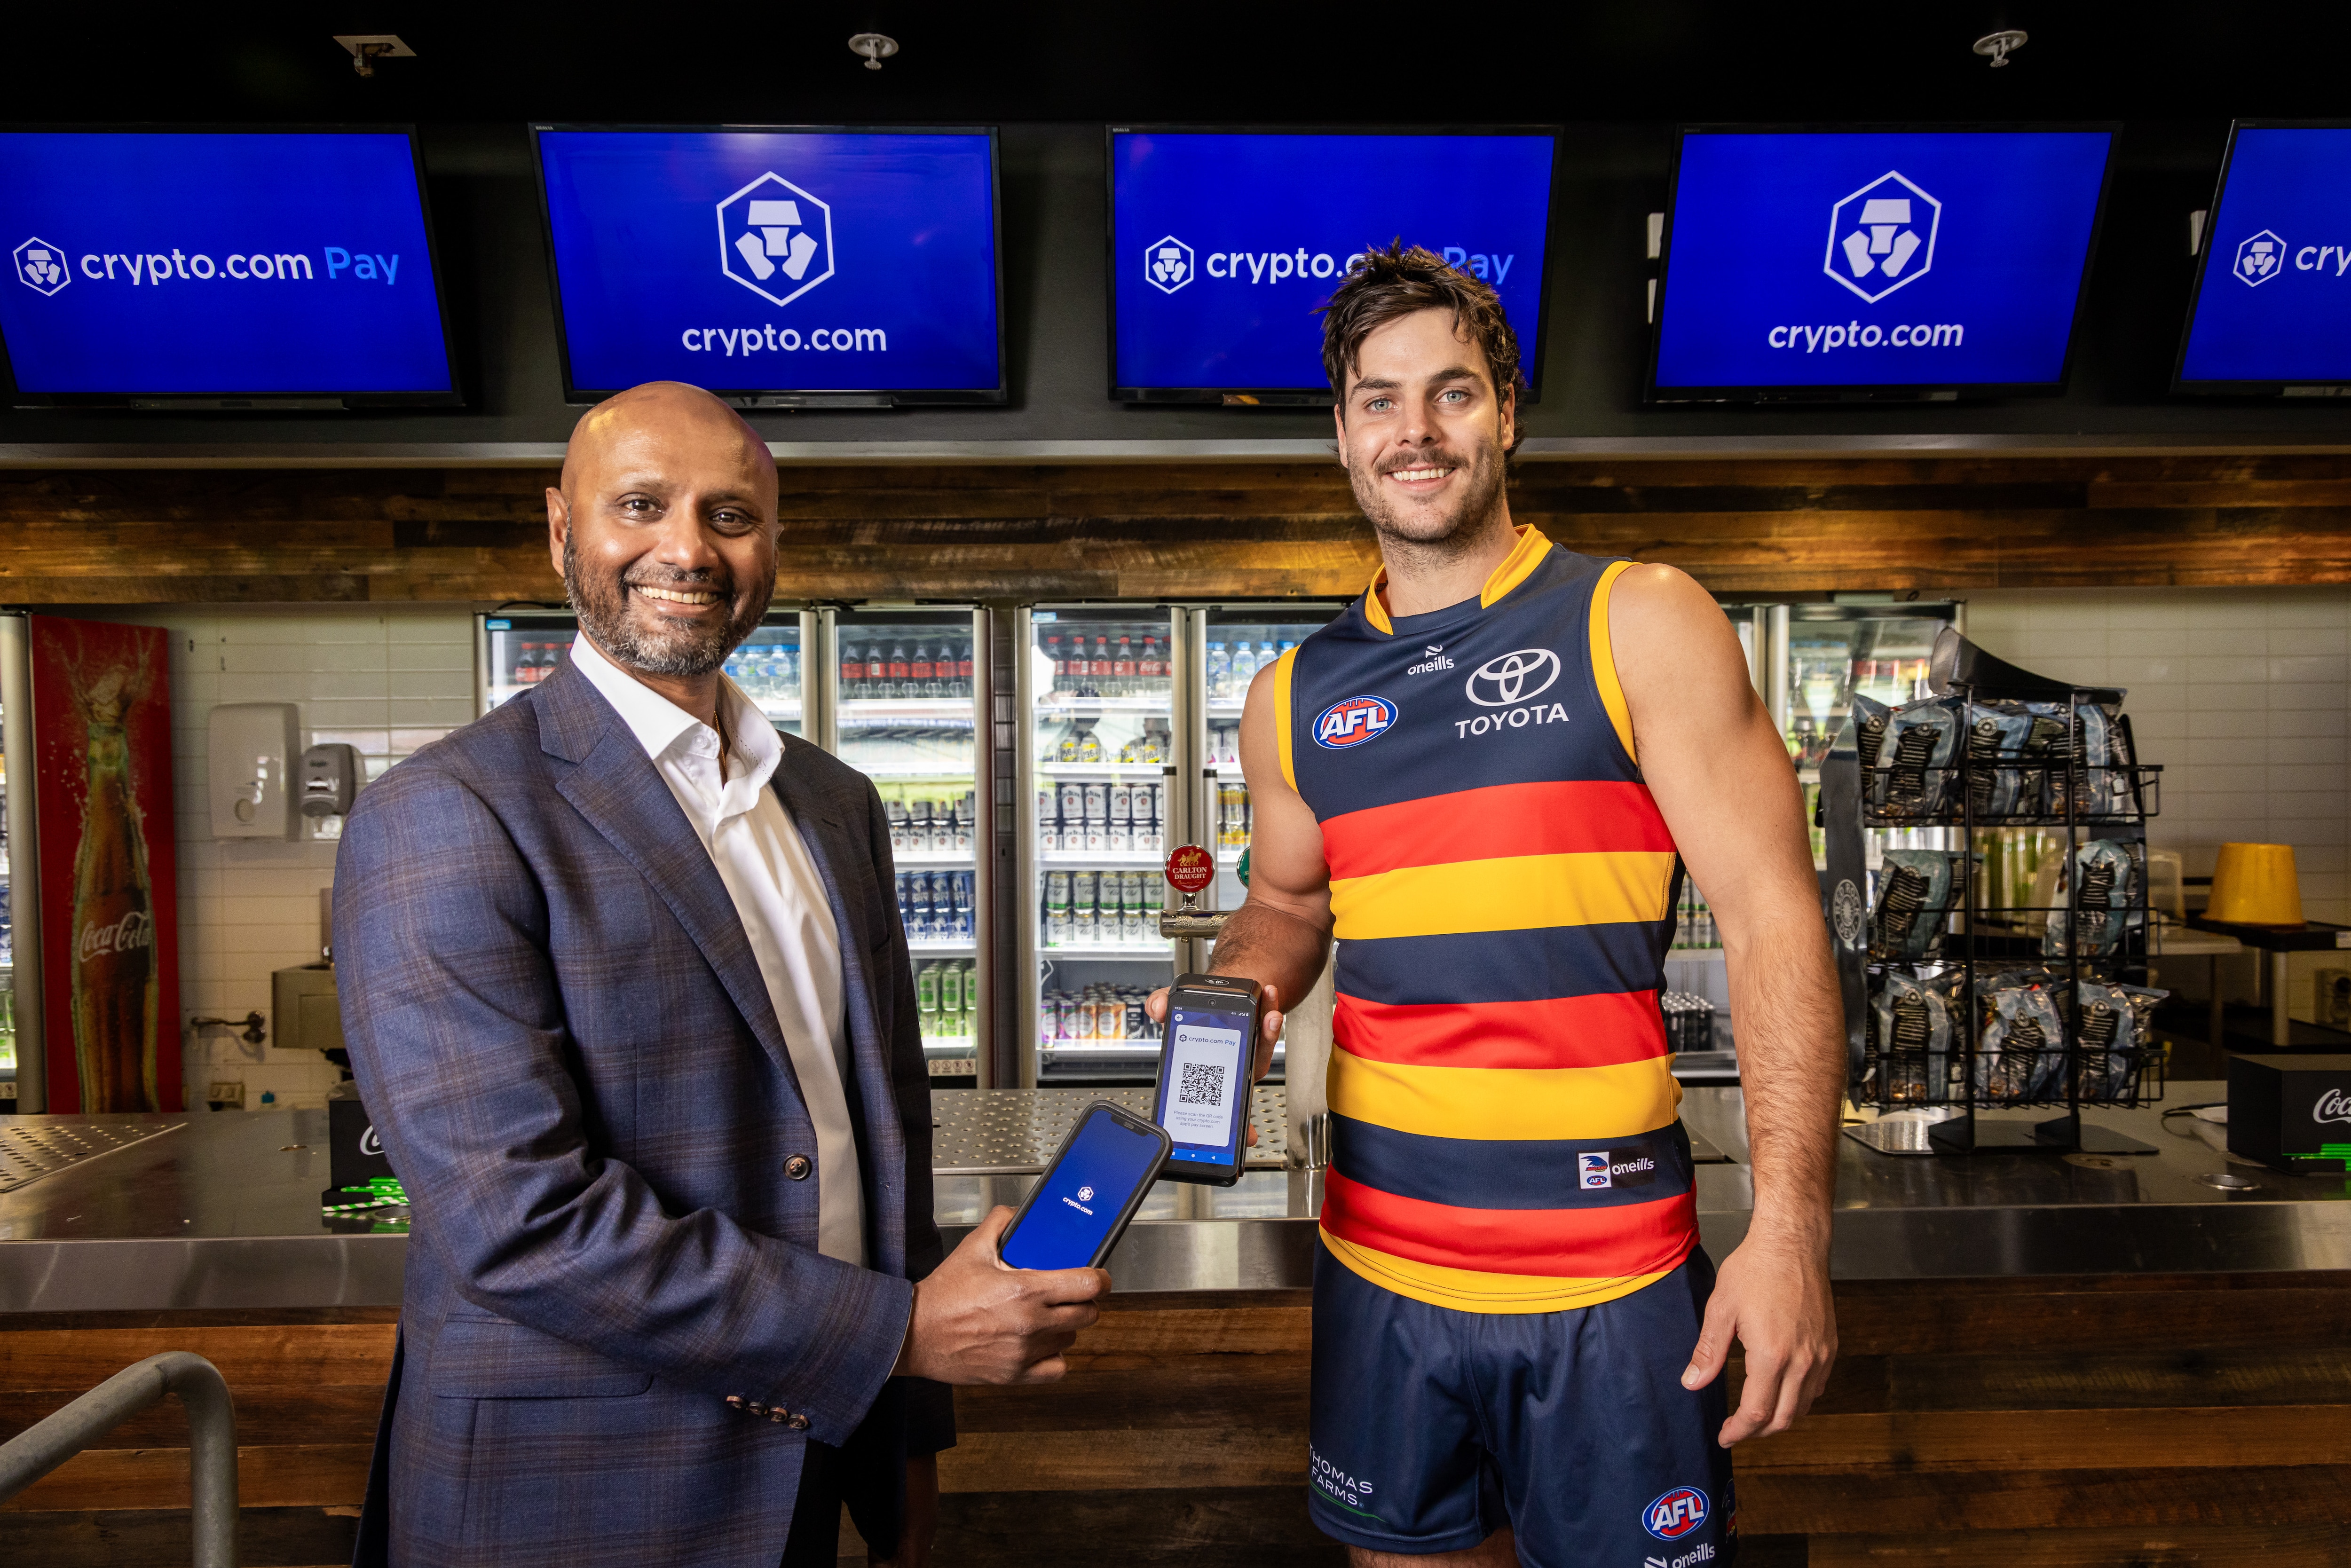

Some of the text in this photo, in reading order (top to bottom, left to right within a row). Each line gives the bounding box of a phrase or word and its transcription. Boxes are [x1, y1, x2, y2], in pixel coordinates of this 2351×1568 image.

[81, 247, 399, 285] crypto.com Pay
[2296, 246, 2351, 276] cry
[682, 323, 886, 356] crypto.com
[1768, 320, 1964, 353] crypto.com
[1319, 705, 1389, 741] AFL
[1455, 702, 1570, 739] TOYOTA
[2312, 1088, 2351, 1124] Coc
[1062, 1197, 1094, 1216] crypto.com
[1309, 1441, 1373, 1494] THOMAS
[1311, 1465, 1358, 1505] FARMS
[1651, 1495, 1704, 1531] AFL
